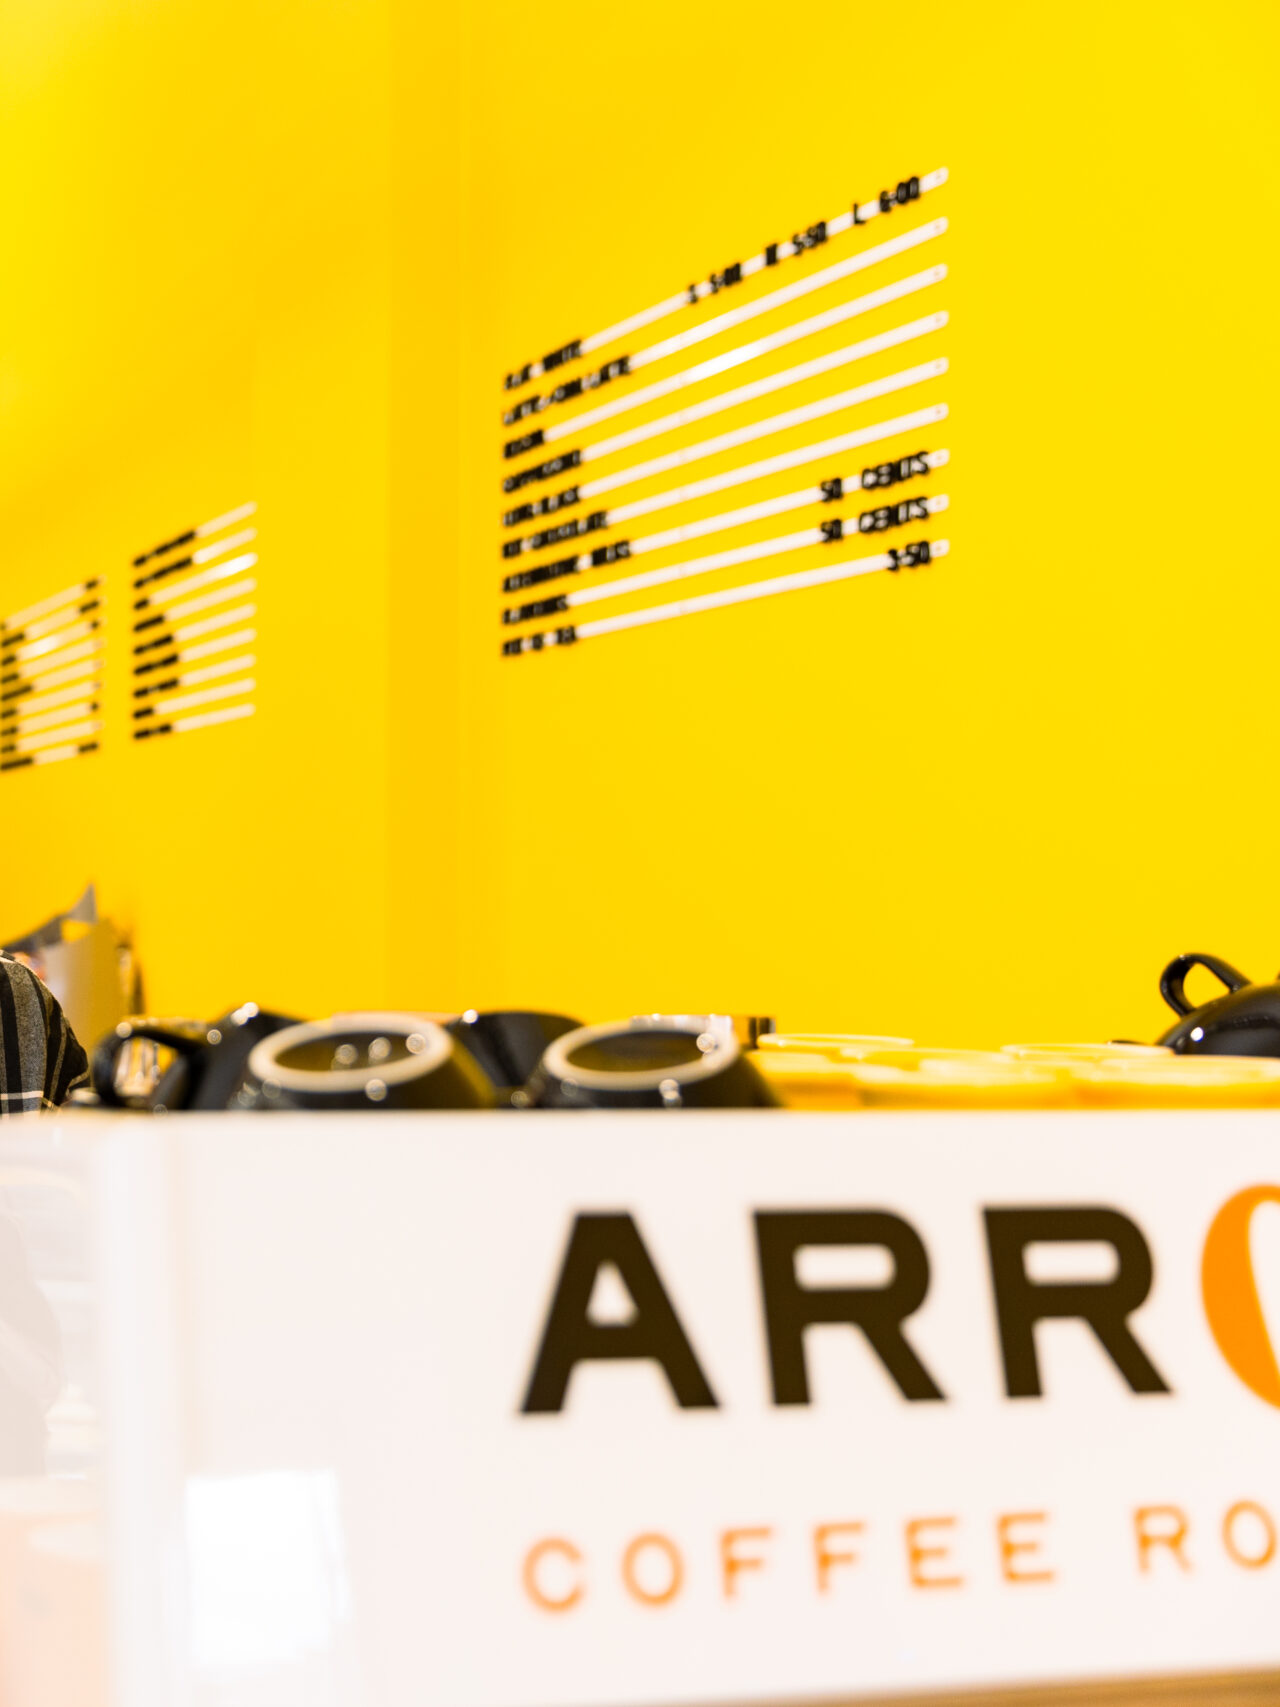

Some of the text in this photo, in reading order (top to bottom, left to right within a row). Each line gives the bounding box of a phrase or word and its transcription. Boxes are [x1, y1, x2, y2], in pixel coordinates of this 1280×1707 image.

[853, 203, 866, 225] L
[861, 451, 929, 490] CENTS
[859, 497, 928, 533] CENTS
[522, 1498, 1277, 1614] COFFEE RO
